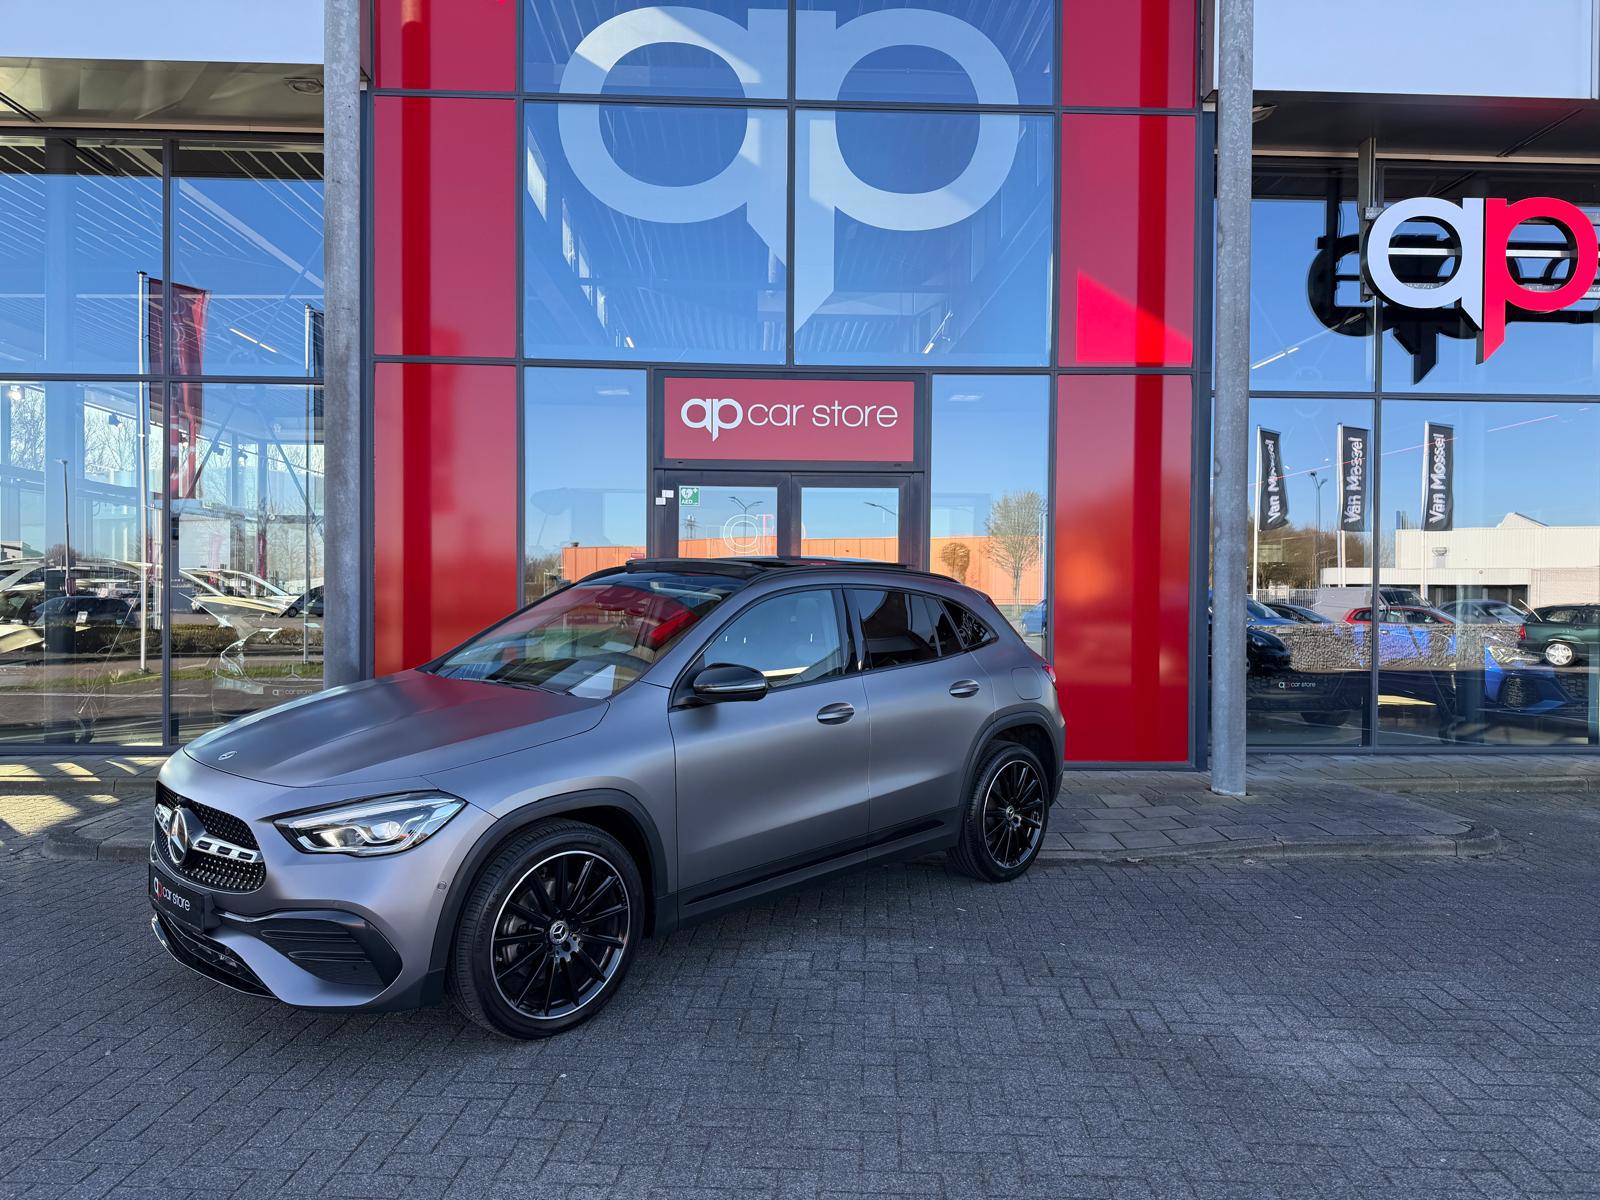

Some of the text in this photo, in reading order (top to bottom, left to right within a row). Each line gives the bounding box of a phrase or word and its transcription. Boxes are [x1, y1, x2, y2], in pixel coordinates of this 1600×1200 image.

[558, 6, 1020, 335] ap
[1367, 196, 1599, 364] ap
[680, 398, 899, 442] ap car store
[1343, 436, 1363, 524] Van Mossel
[1428, 433, 1447, 524] Van Mossel
[162, 886, 173, 900] car
[172, 893, 191, 911] store
